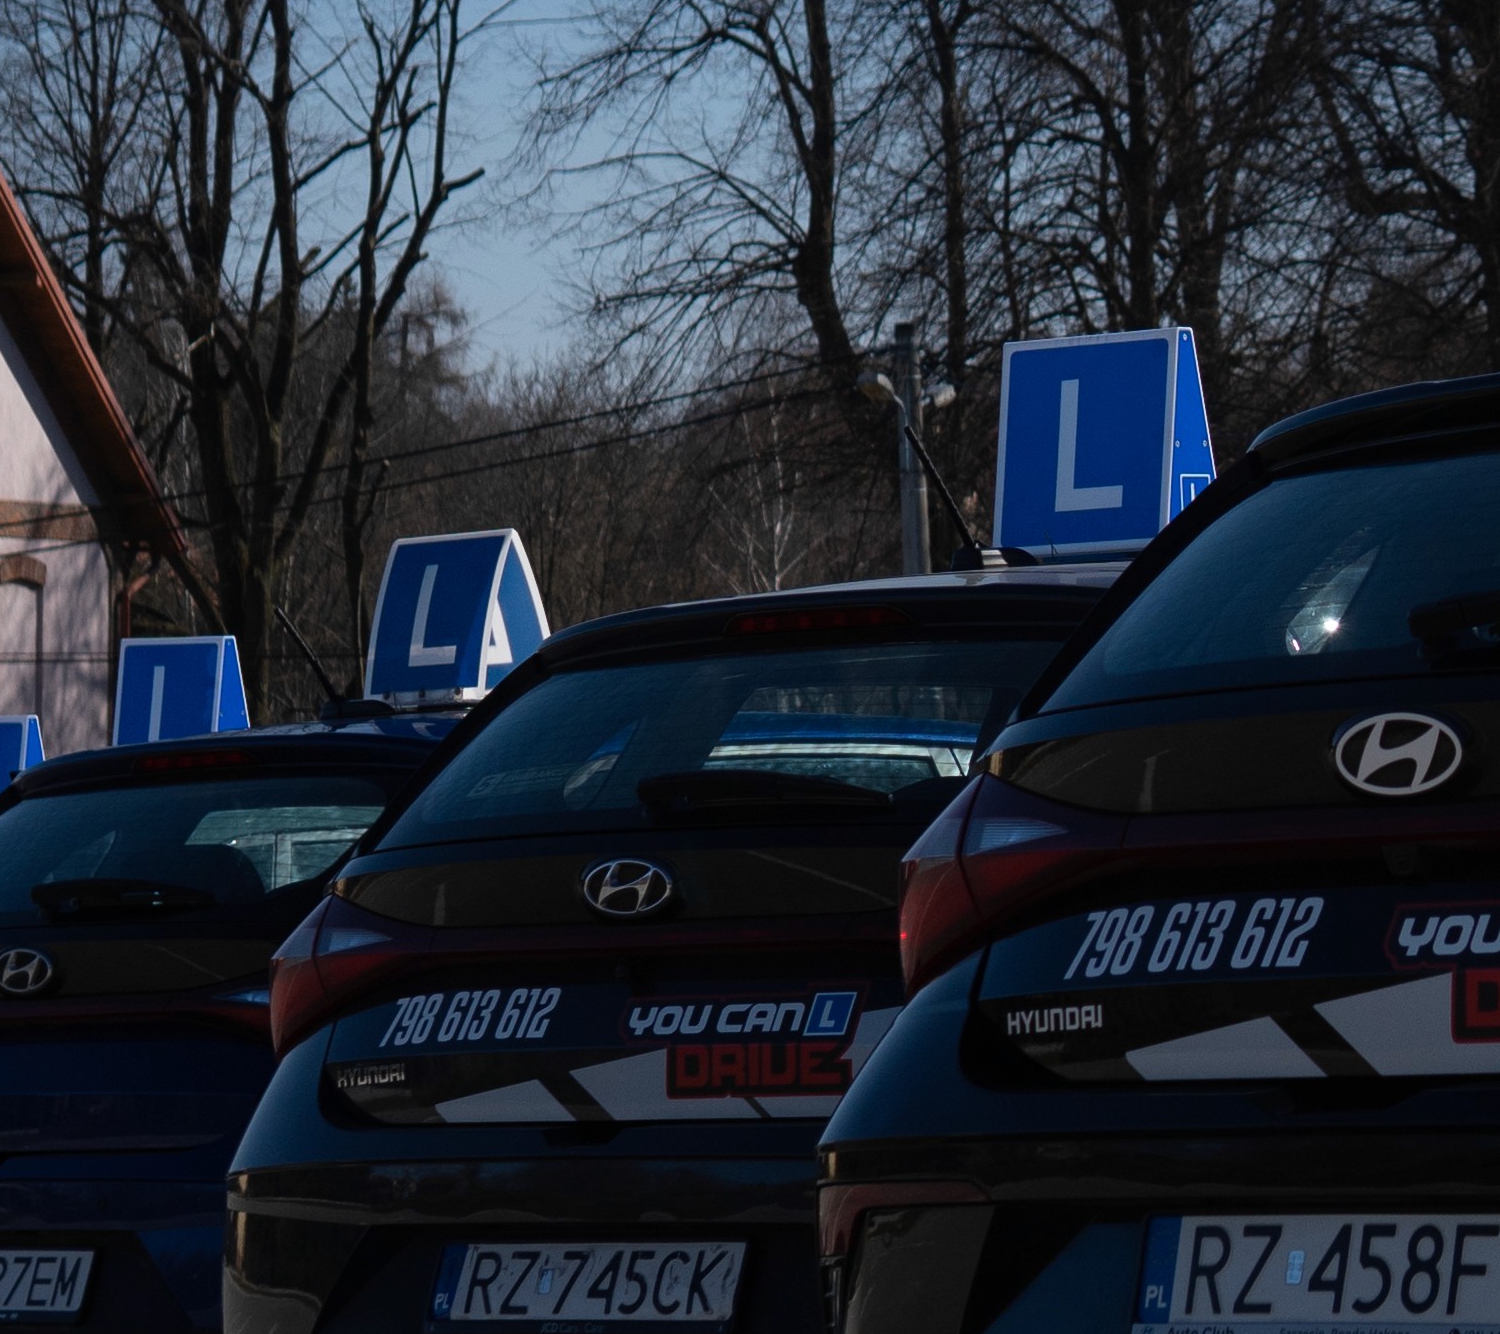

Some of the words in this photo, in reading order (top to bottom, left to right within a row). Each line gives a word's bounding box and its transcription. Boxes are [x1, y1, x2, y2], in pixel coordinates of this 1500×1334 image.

[1054, 379, 1124, 512] L
[408, 564, 457, 667] L
[1063, 904, 1155, 981] 798
[1148, 899, 1237, 973] 613
[1230, 896, 1325, 970] 612
[378, 992, 444, 1048] 798
[436, 989, 501, 1043] 613
[494, 987, 562, 1040] 612
[627, 1004, 714, 1036] YOU
[716, 1002, 806, 1034] CAN
[818, 999, 835, 1028] L
[1006, 1004, 1103, 1036] HYUNDAI
[337, 1063, 405, 1088] HYUNDAI
[675, 1042, 843, 1089] DRIVE
[464, 1250, 541, 1315] RZ
[552, 1250, 728, 1315] 745CK
[1184, 1224, 1283, 1315] RZ
[434, 1292, 450, 1310] PL
[1144, 1285, 1167, 1310] PL
